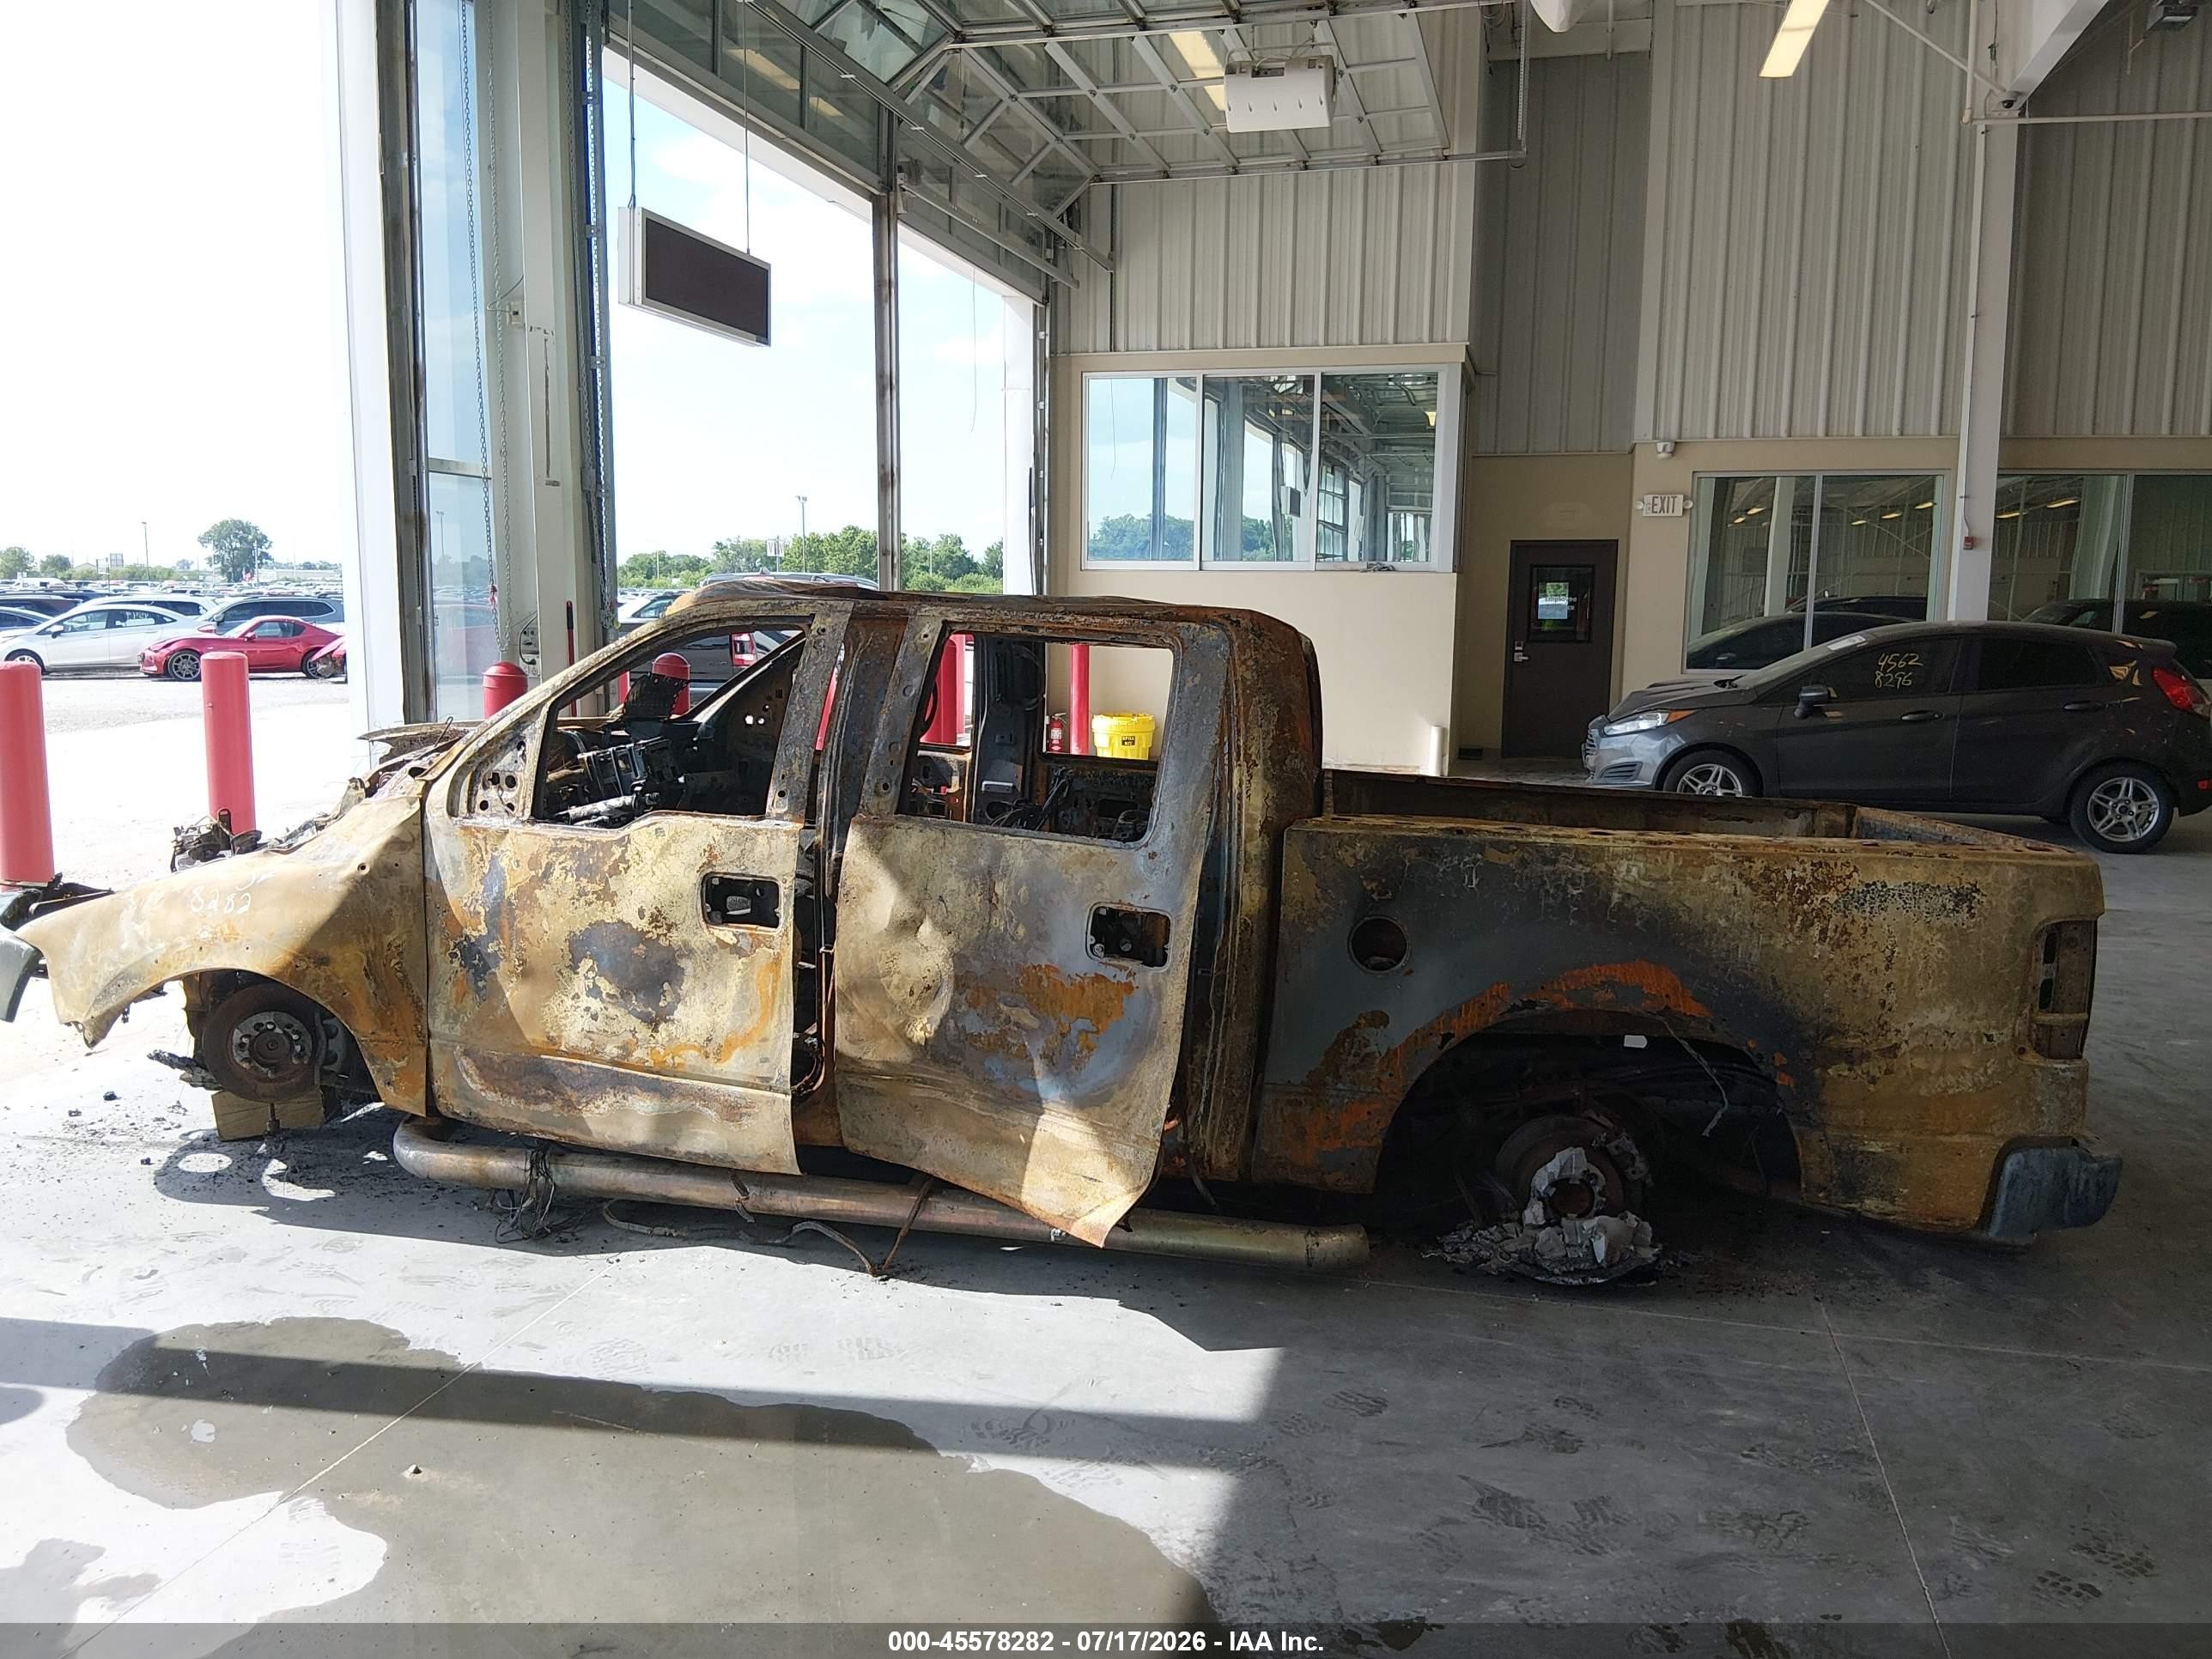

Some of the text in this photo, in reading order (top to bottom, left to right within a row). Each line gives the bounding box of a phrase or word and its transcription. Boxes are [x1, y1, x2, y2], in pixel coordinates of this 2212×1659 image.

[1651, 495, 1677, 514] EXIT
[1878, 653, 1923, 672] 4562
[1875, 671, 1912, 689] 8296
[191, 885, 252, 915] 8282
